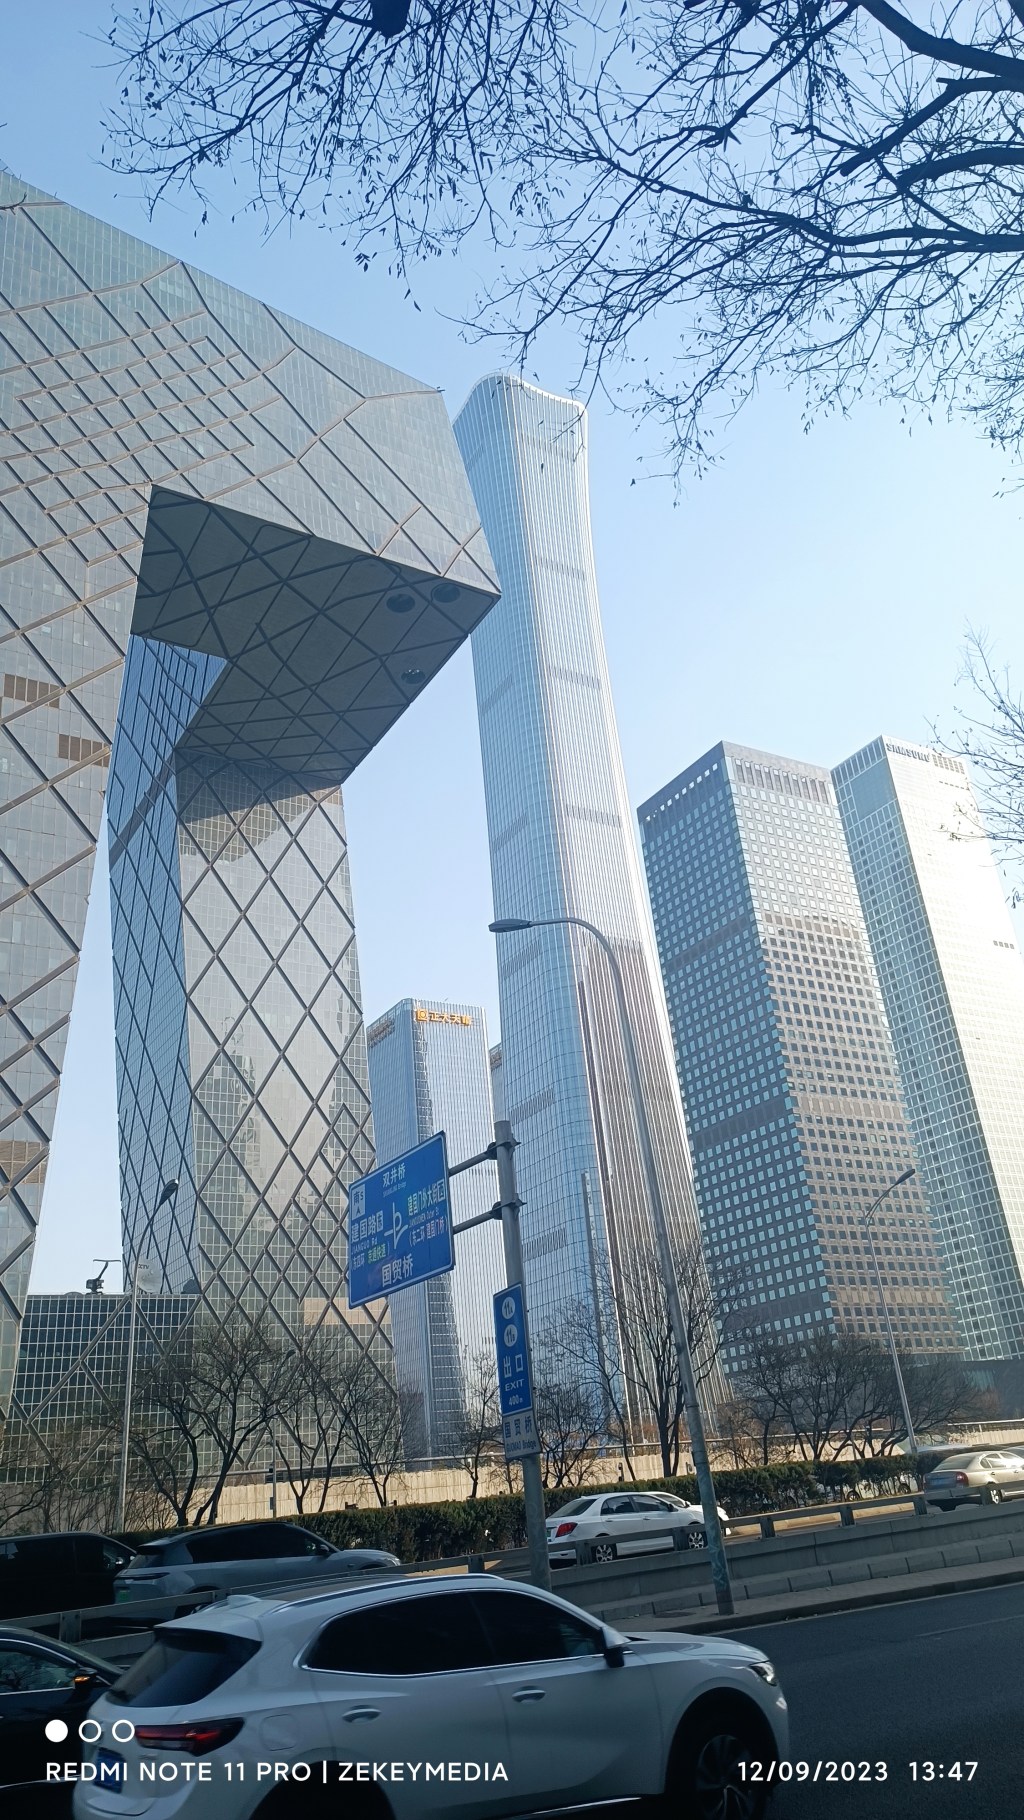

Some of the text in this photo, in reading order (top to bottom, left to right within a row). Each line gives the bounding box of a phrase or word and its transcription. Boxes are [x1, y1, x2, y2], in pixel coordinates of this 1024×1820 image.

[886, 743, 929, 762] SAMSUNG
[383, 1163, 405, 1187] 双井桥
[351, 1214, 376, 1243] 建国路
[382, 1253, 413, 1287] 国贸桥
[503, 1354, 524, 1379] 出口
[505, 1379, 524, 1391] EXIT
[505, 1416, 532, 1438] 国贸桥
